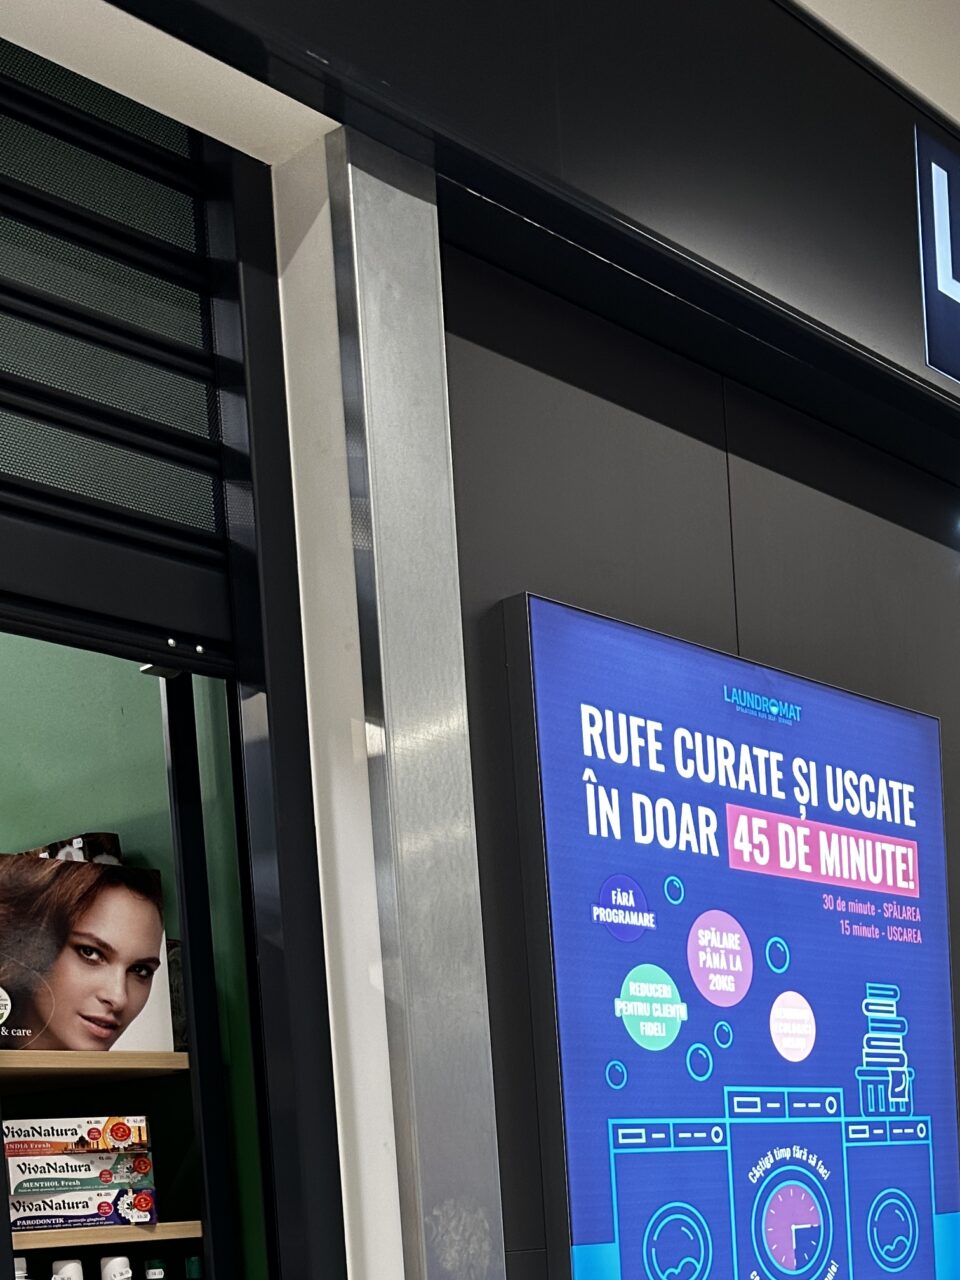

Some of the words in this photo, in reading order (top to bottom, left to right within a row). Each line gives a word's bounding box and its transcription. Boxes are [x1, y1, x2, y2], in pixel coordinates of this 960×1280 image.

[723, 684, 802, 722] LAUNDROMAT
[580, 703, 665, 773] RUFE
[673, 727, 785, 800] CURATE
[792, 757, 819, 820] ȘI
[826, 765, 917, 828] USCATE
[583, 768, 622, 840] ÎN
[632, 794, 720, 858] DOAR
[733, 814, 770, 866] 45
[778, 823, 812, 873] DE
[819, 830, 916, 890] MINUTE!
[611, 888, 636, 907] FĂRĂ
[822, 893, 834, 911] 30
[836, 896, 846, 912] de
[848, 899, 876, 917] minute
[883, 901, 922, 923] SPĂLAREA
[592, 906, 656, 929] PROGRAMARE
[697, 927, 741, 951] SPĂLARE
[840, 919, 851, 936] 15
[852, 922, 880, 940] minute
[887, 926, 922, 945] USCAREA
[698, 947, 728, 970] PÂNĂ
[729, 954, 743, 972] LA
[708, 973, 736, 992] 20KG
[11, 1028, 32, 1037] care
[3, 1126, 78, 1138] VivaNatura
[17, 1162, 91, 1175] VivaNatura
[774, 1147, 792, 1161] timp
[792, 1145, 809, 1160] fără
[808, 1153, 818, 1166] să
[816, 1160, 831, 1181] faci
[11, 1200, 90, 1213] VivaNatura
